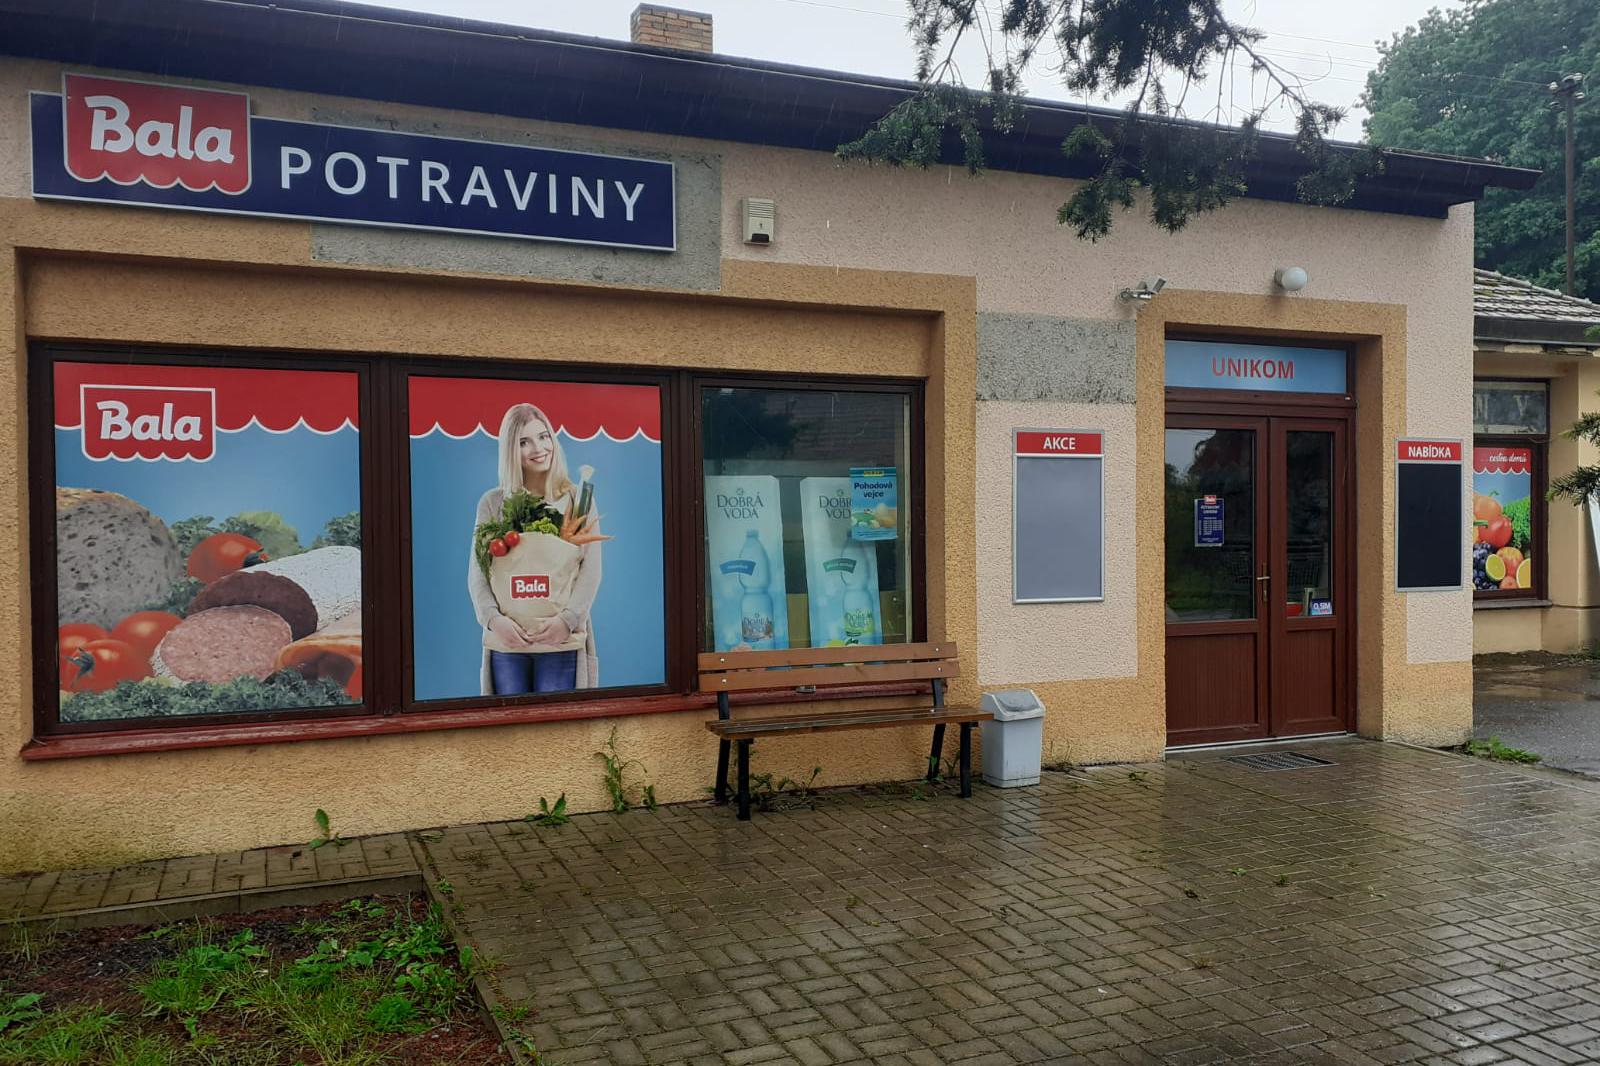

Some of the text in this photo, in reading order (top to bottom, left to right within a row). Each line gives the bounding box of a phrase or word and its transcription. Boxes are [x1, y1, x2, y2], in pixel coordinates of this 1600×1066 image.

[84, 95, 235, 164] Bala
[279, 146, 645, 221] POTRAVINY
[1212, 356, 1294, 379] UNIKOM
[96, 400, 203, 441] Bala
[1043, 436, 1076, 450] AKCE
[1408, 444, 1452, 458] NABÍDKA
[854, 481, 893, 489] Pohodová
[716, 491, 764, 508] DOBRÁ
[819, 495, 852, 508] DOBR
[864, 490, 884, 499] vejce
[723, 507, 759, 519] VODA
[825, 508, 852, 519] VOD
[515, 579, 547, 593] Bala
